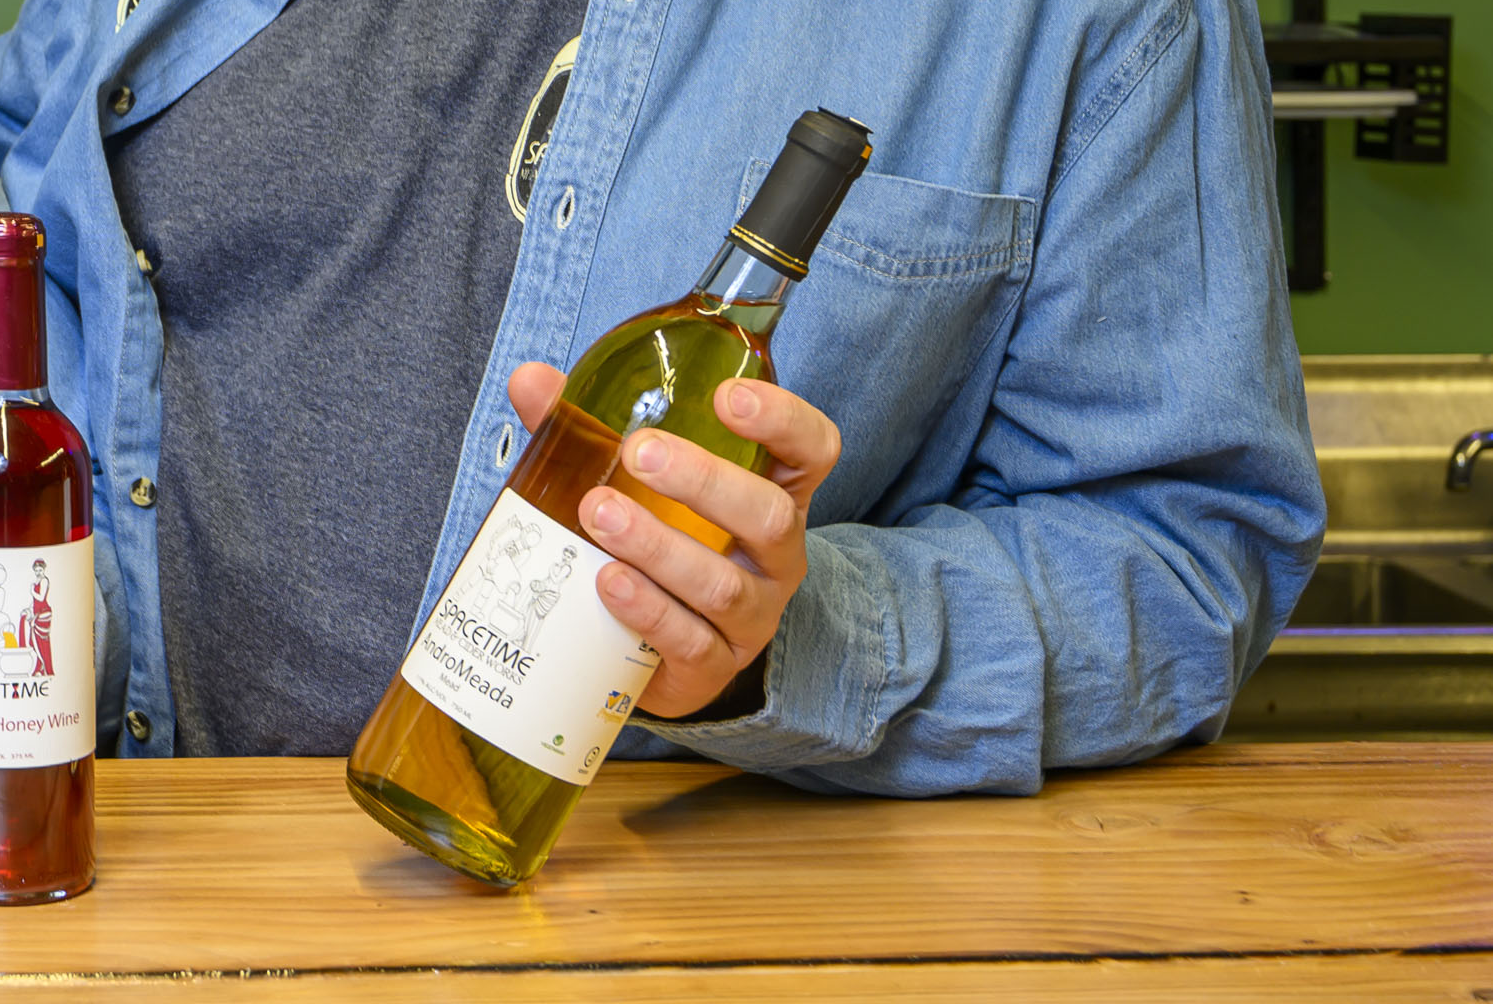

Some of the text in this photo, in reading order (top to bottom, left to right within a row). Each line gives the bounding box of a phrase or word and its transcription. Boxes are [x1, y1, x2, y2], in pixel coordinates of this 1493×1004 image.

[439, 599, 535, 677] SPACETIME
[423, 632, 514, 709] AndroMeada
[486, 654, 524, 686] WORKS
[48, 711, 80, 729] Wine
